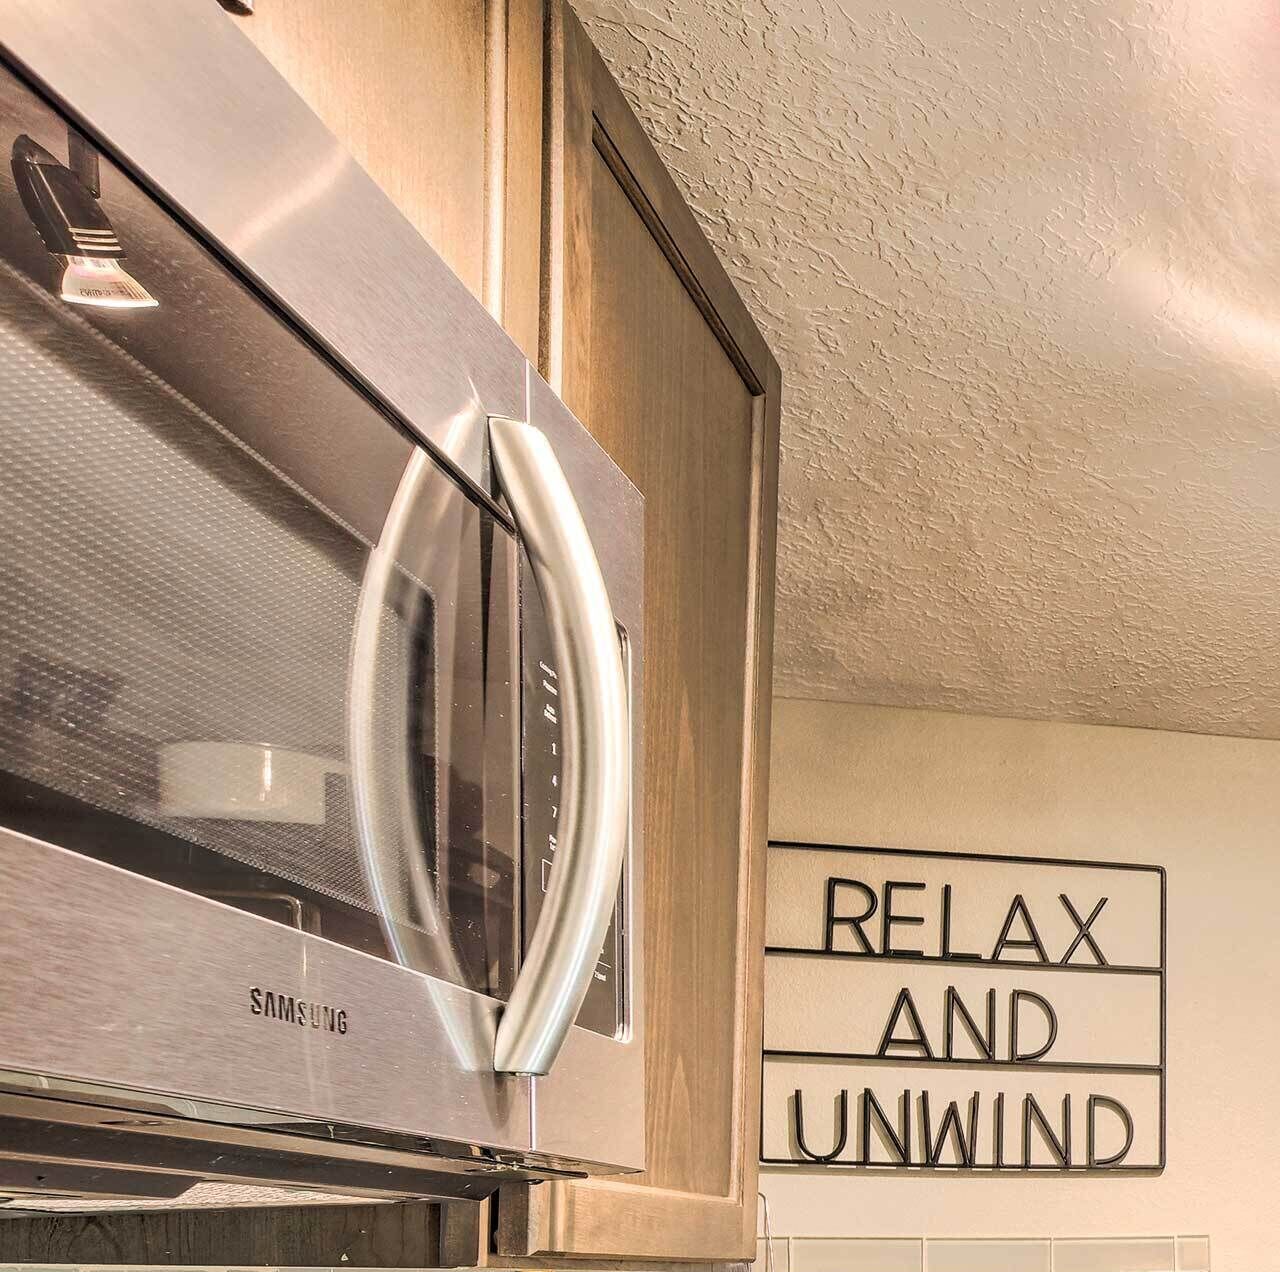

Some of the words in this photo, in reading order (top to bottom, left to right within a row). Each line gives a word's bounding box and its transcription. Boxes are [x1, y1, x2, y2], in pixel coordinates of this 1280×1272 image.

[824, 876, 1108, 966] RELAX
[250, 986, 347, 1034] SAMSUNG
[877, 985, 1058, 1062] AND
[792, 1087, 1134, 1167] UNWIND
